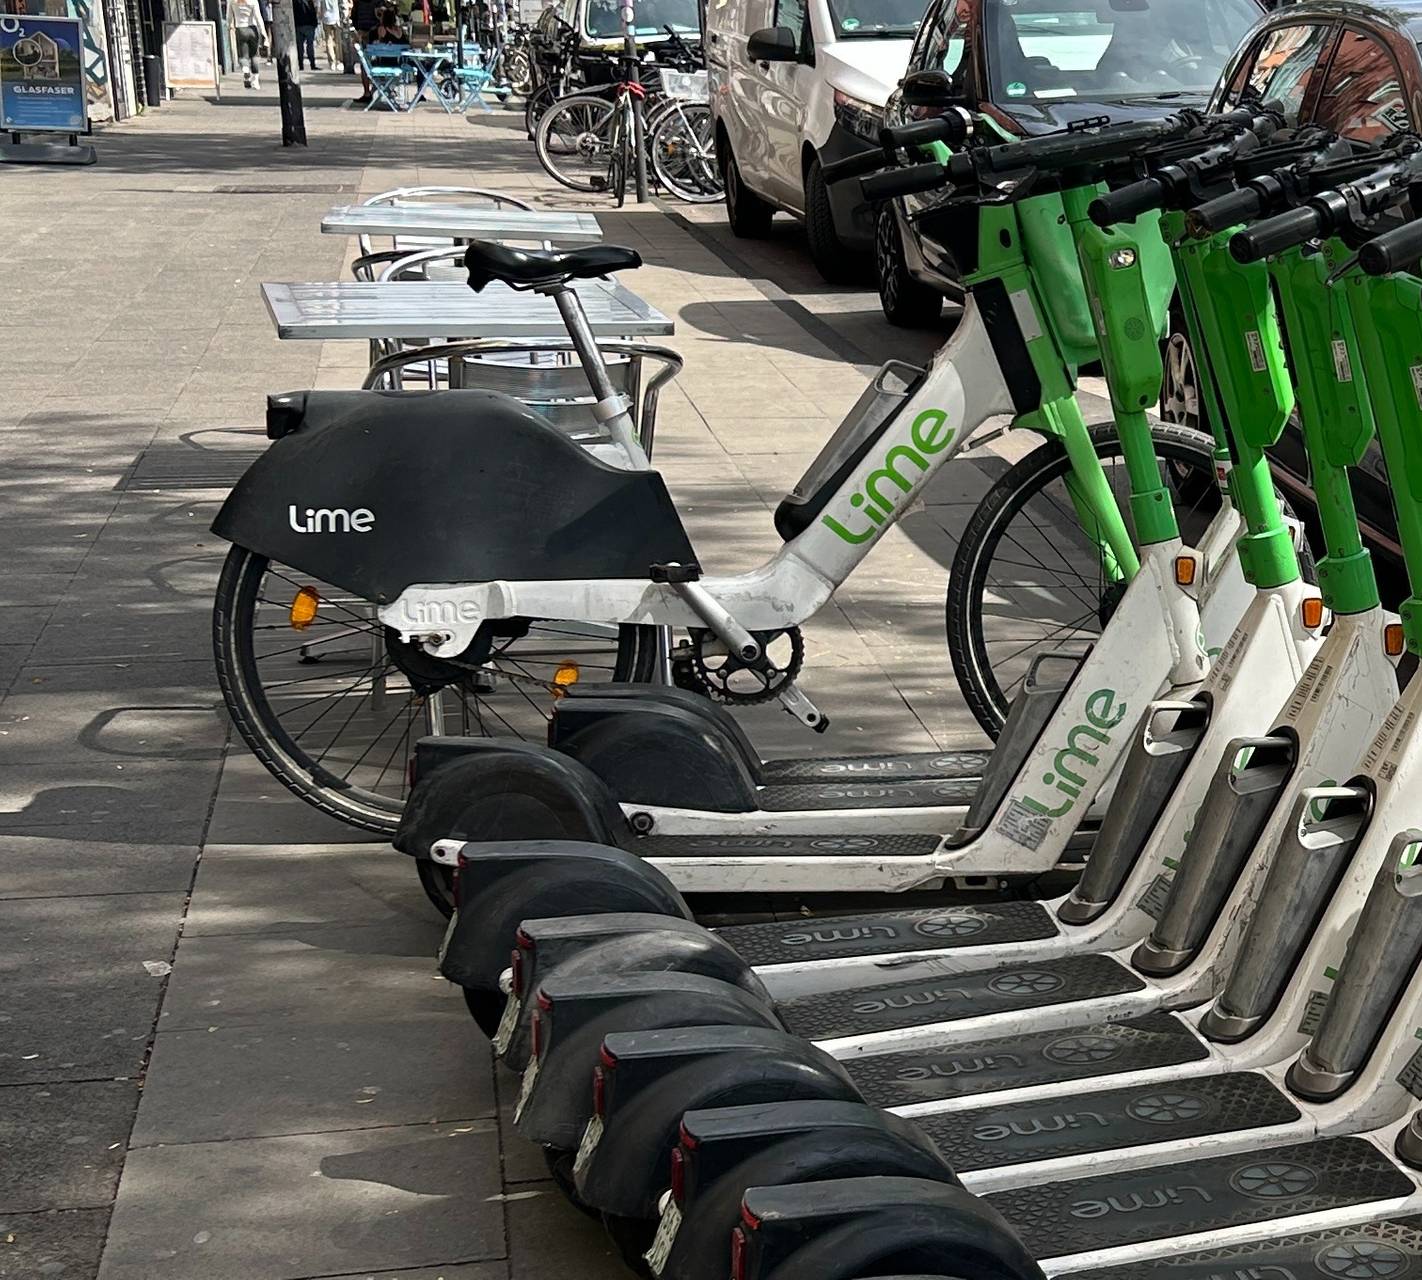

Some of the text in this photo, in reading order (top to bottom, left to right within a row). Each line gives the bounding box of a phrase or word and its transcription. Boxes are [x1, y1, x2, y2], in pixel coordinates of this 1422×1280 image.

[13, 85, 75, 95] GLASFASER
[822, 408, 956, 545] Lime
[289, 505, 376, 533] Lime
[400, 597, 482, 624] Lime
[1022, 688, 1127, 819] Lime
[780, 926, 897, 947] Lime
[853, 987, 973, 1015] Lime
[898, 1051, 1026, 1081] Lime
[973, 1109, 1111, 1142] Lime
[1069, 1184, 1214, 1220] Lime
